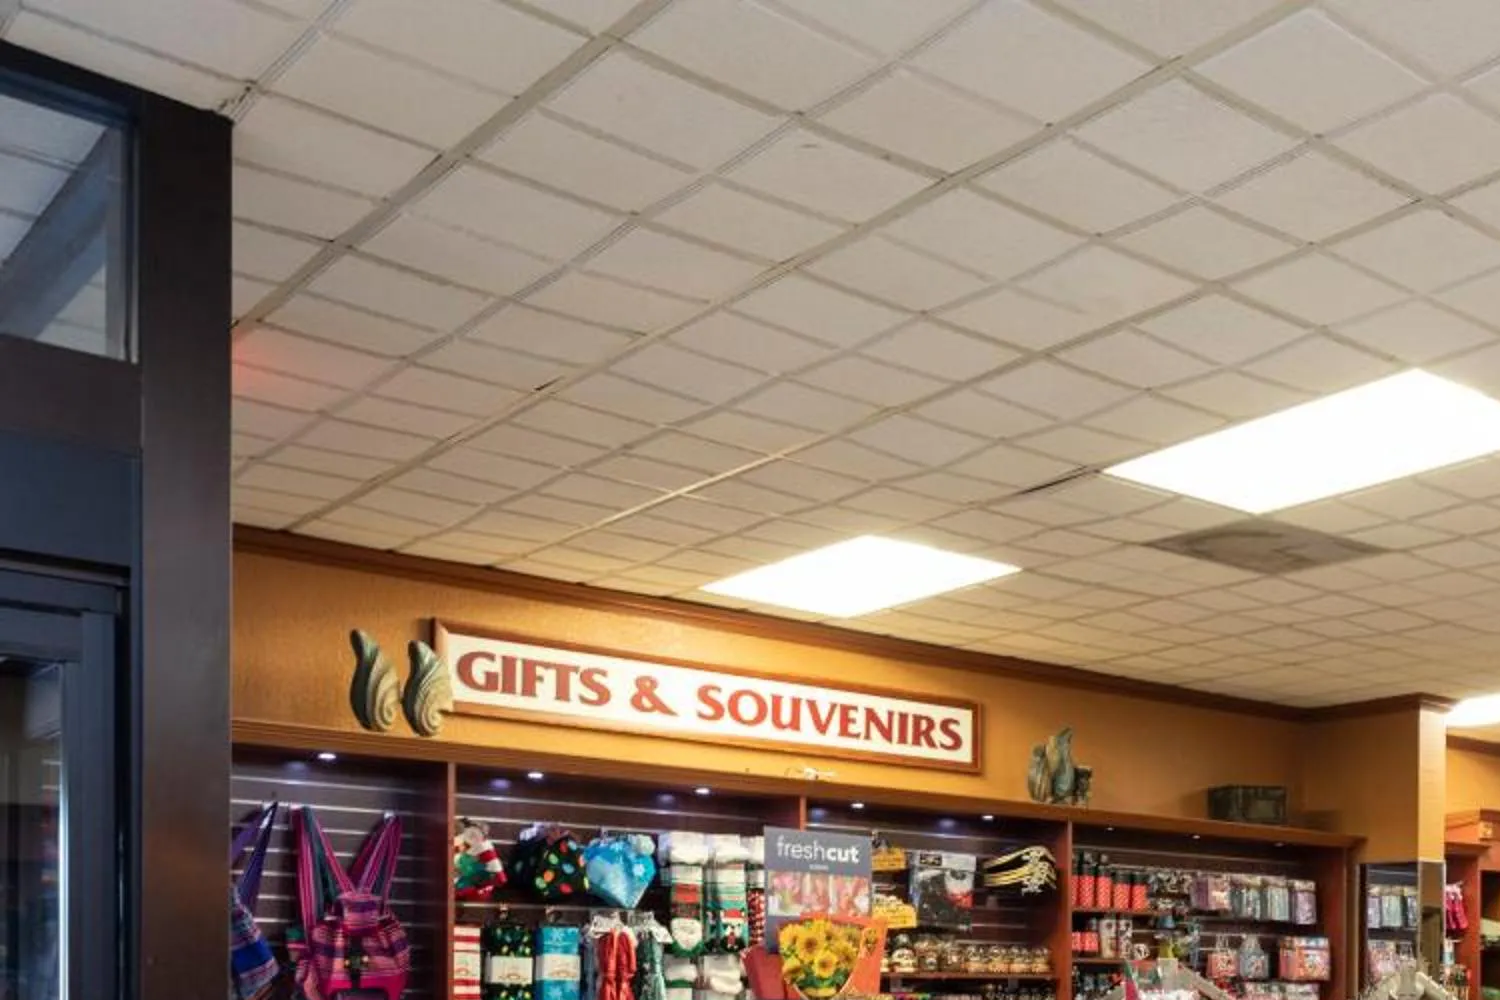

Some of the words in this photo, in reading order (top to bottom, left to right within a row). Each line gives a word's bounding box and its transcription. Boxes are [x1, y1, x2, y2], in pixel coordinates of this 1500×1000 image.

[456, 651, 612, 706] GIFTS
[630, 675, 677, 716] &
[696, 684, 964, 751] SOUVENIRS
